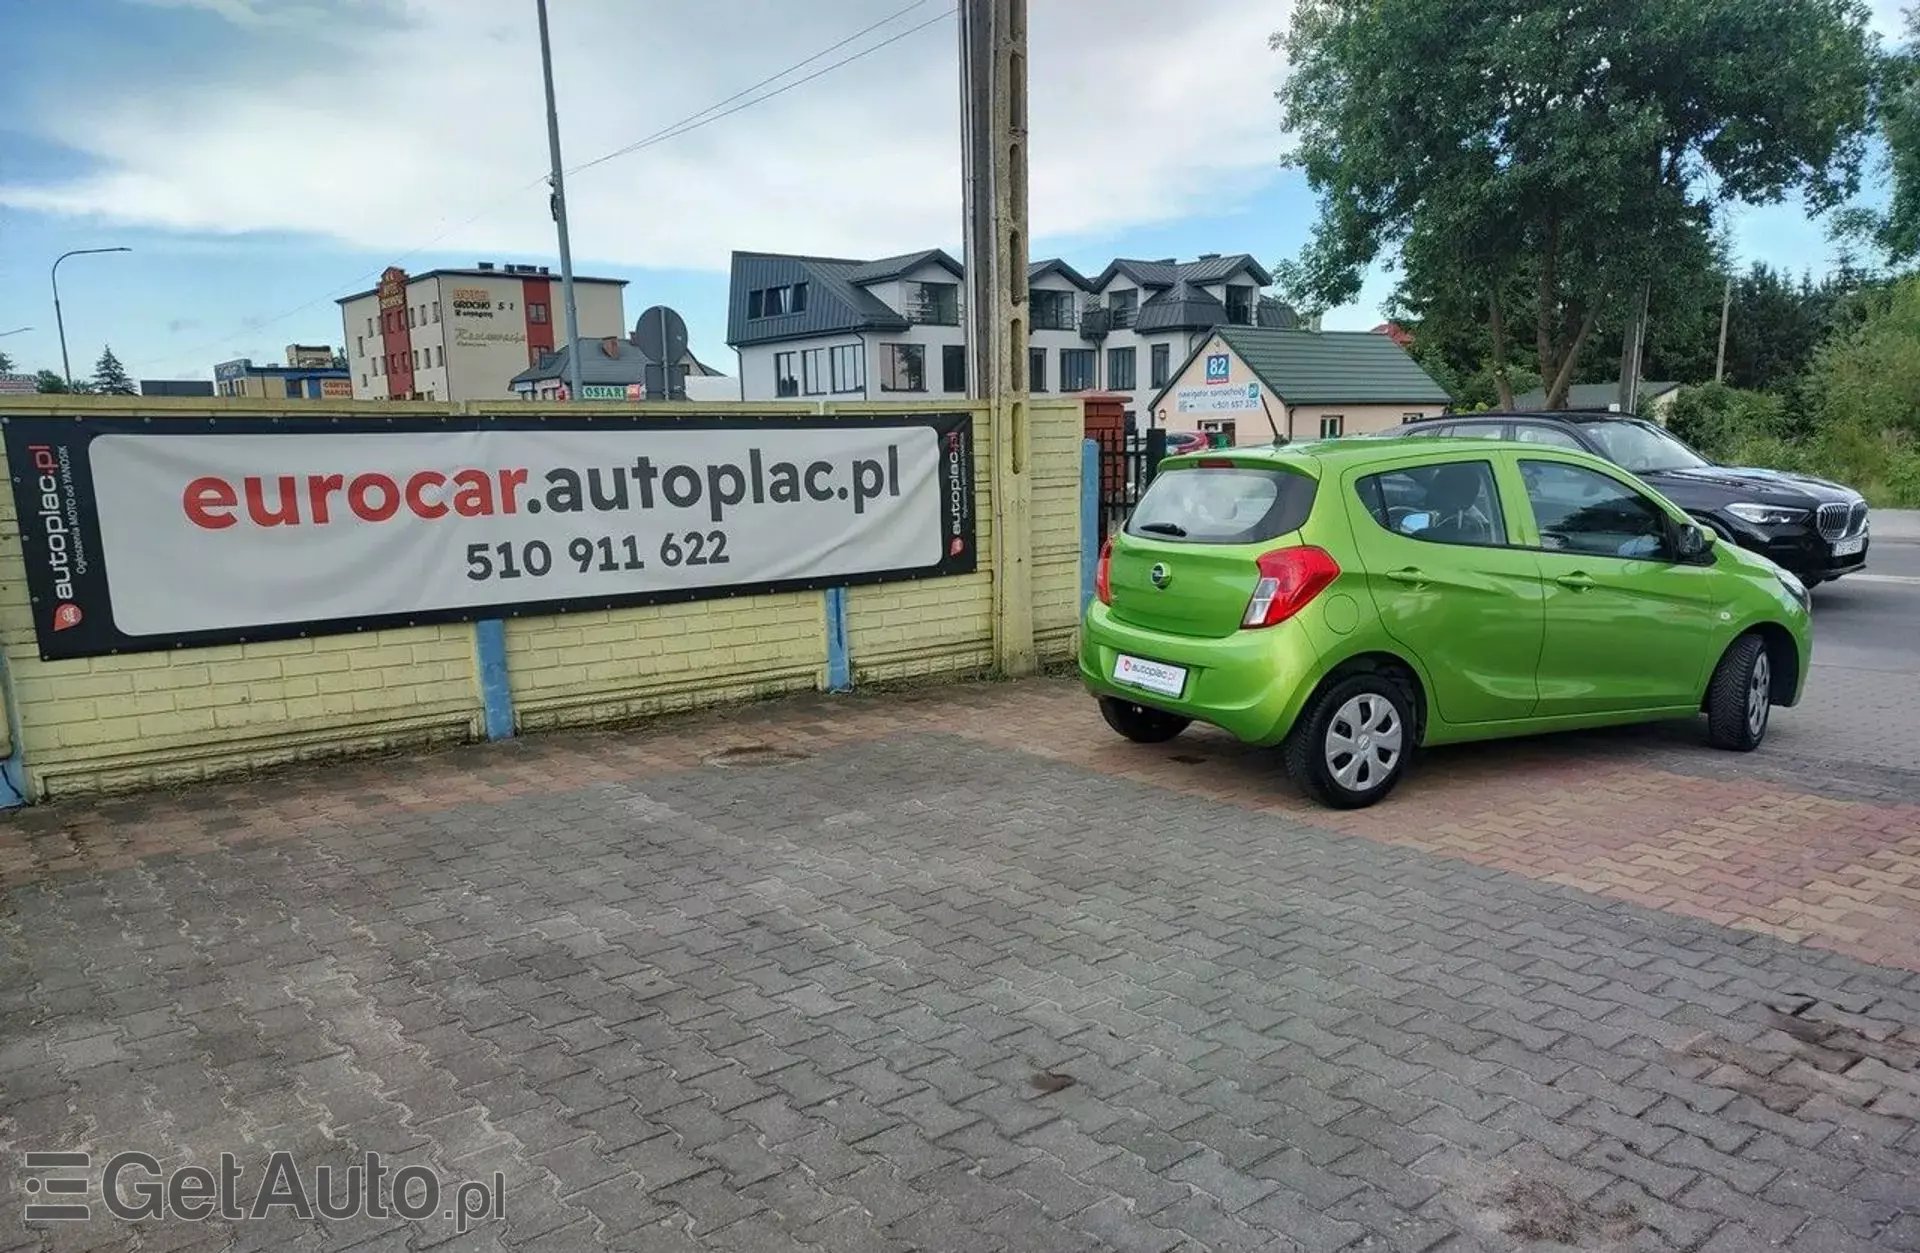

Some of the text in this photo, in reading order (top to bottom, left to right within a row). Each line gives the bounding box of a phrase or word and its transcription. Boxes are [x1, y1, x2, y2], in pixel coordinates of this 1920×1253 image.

[1209, 358, 1226, 375] 82
[57, 445, 72, 484] YANOSIK
[946, 432, 962, 535] autoplac.pl
[64, 485, 75, 498] od
[183, 445, 900, 529] eurocar.autoplac.pl
[28, 445, 73, 600] autoplac.pl
[66, 497, 79, 527] MOTO
[467, 530, 730, 580] 510 911 622
